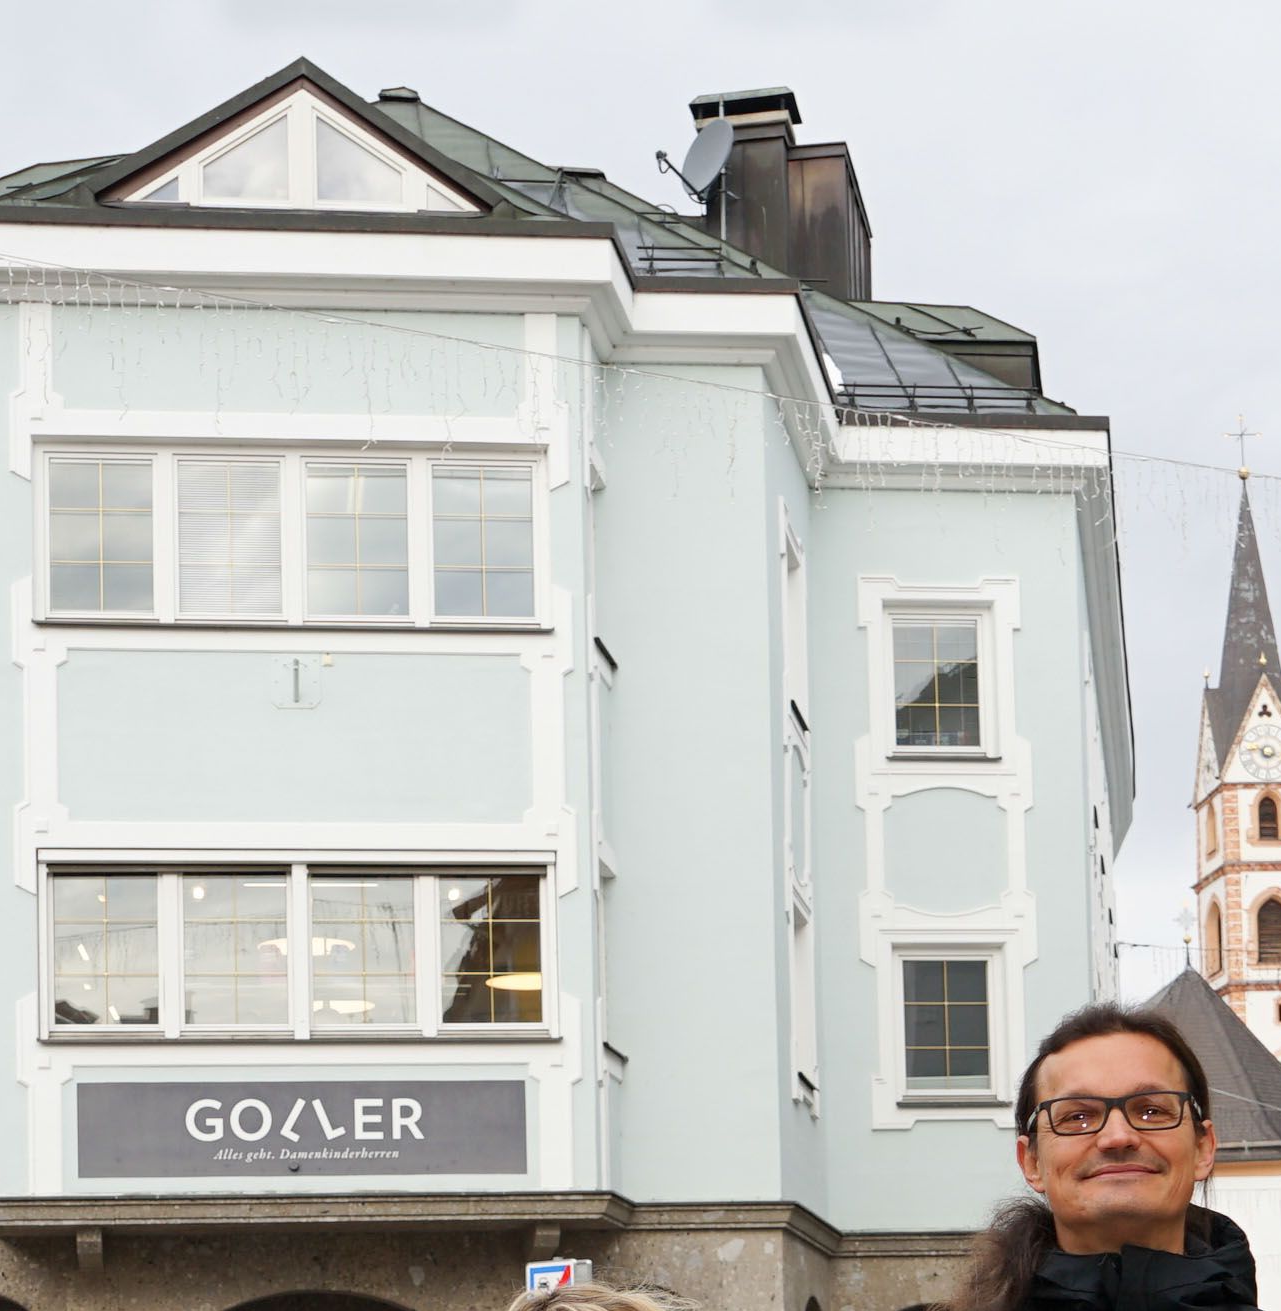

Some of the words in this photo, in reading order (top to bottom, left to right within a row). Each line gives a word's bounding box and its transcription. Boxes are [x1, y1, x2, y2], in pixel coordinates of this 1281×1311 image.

[185, 1098, 425, 1143] GOLLER
[213, 1148, 243, 1160] Alles
[245, 1149, 275, 1163] geht.
[279, 1148, 400, 1161] Damenkinderherren
